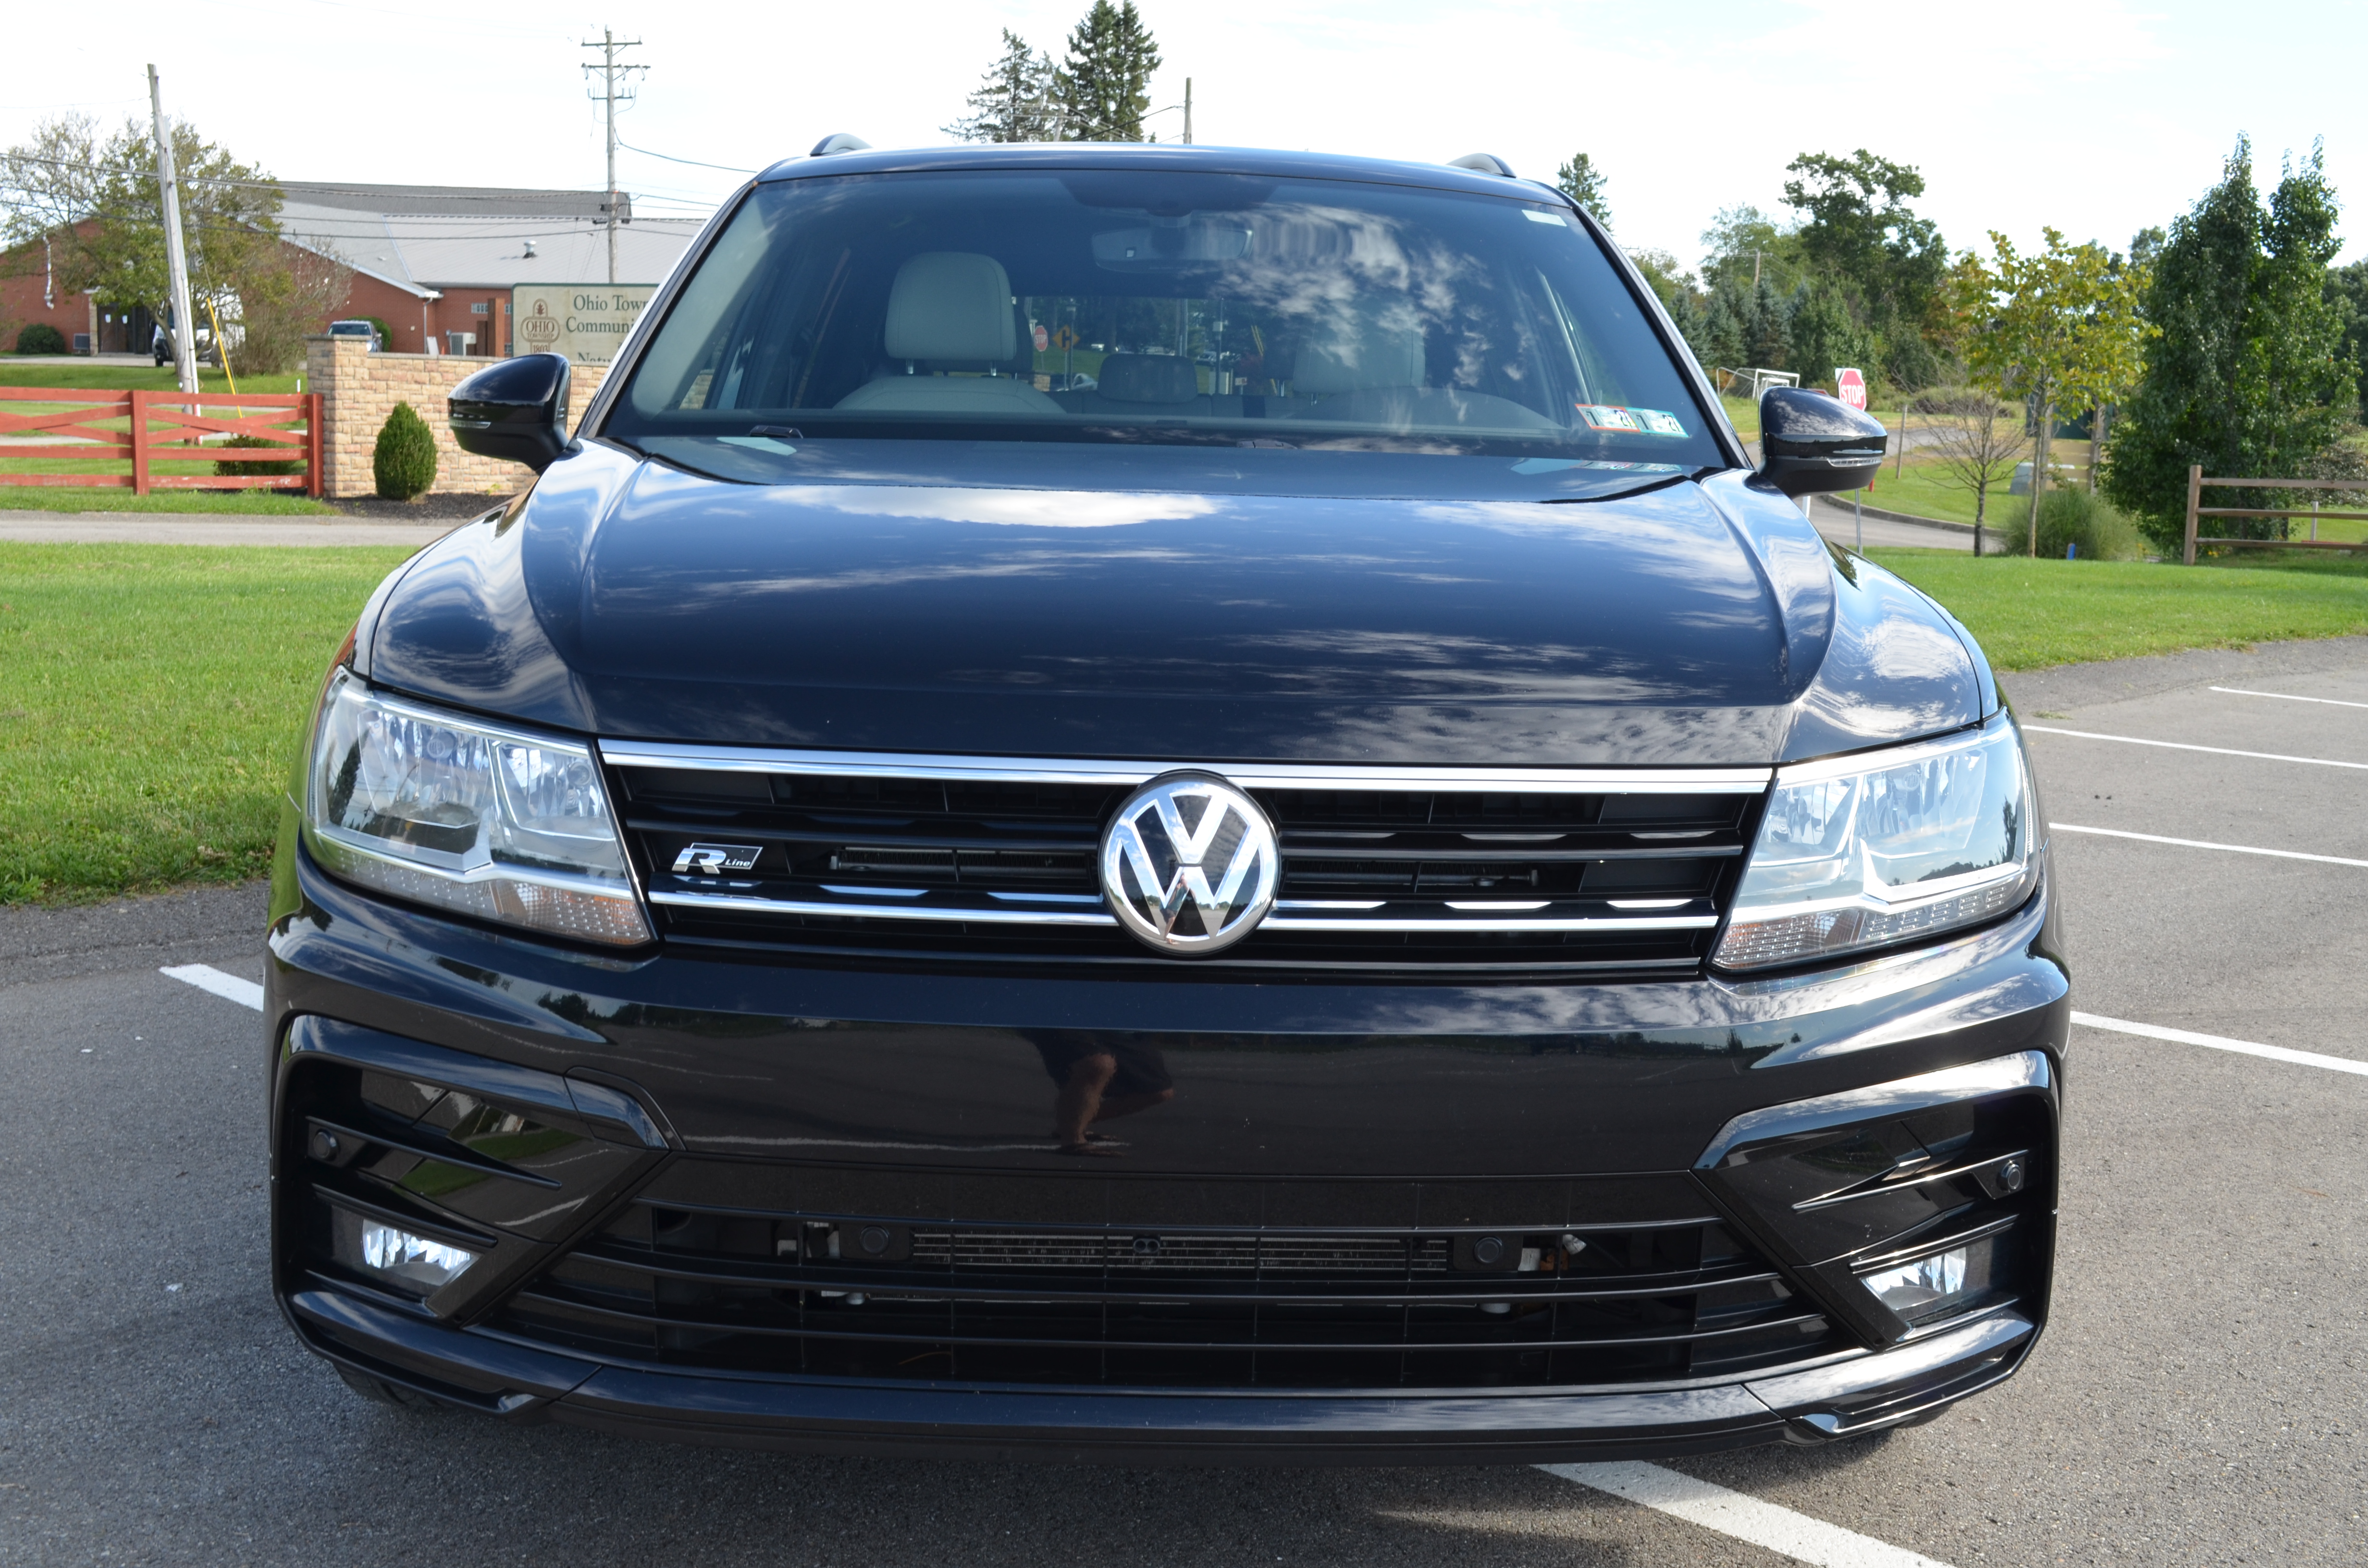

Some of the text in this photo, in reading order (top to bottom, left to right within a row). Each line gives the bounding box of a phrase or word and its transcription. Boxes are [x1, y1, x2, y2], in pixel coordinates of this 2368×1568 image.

[573, 294, 608, 311] Ohio
[526, 320, 555, 333] OHIO
[1035, 334, 1047, 344] STOP
[1841, 385, 1863, 404] STOP
[672, 847, 727, 874] R
[1109, 782, 1272, 947] VW
